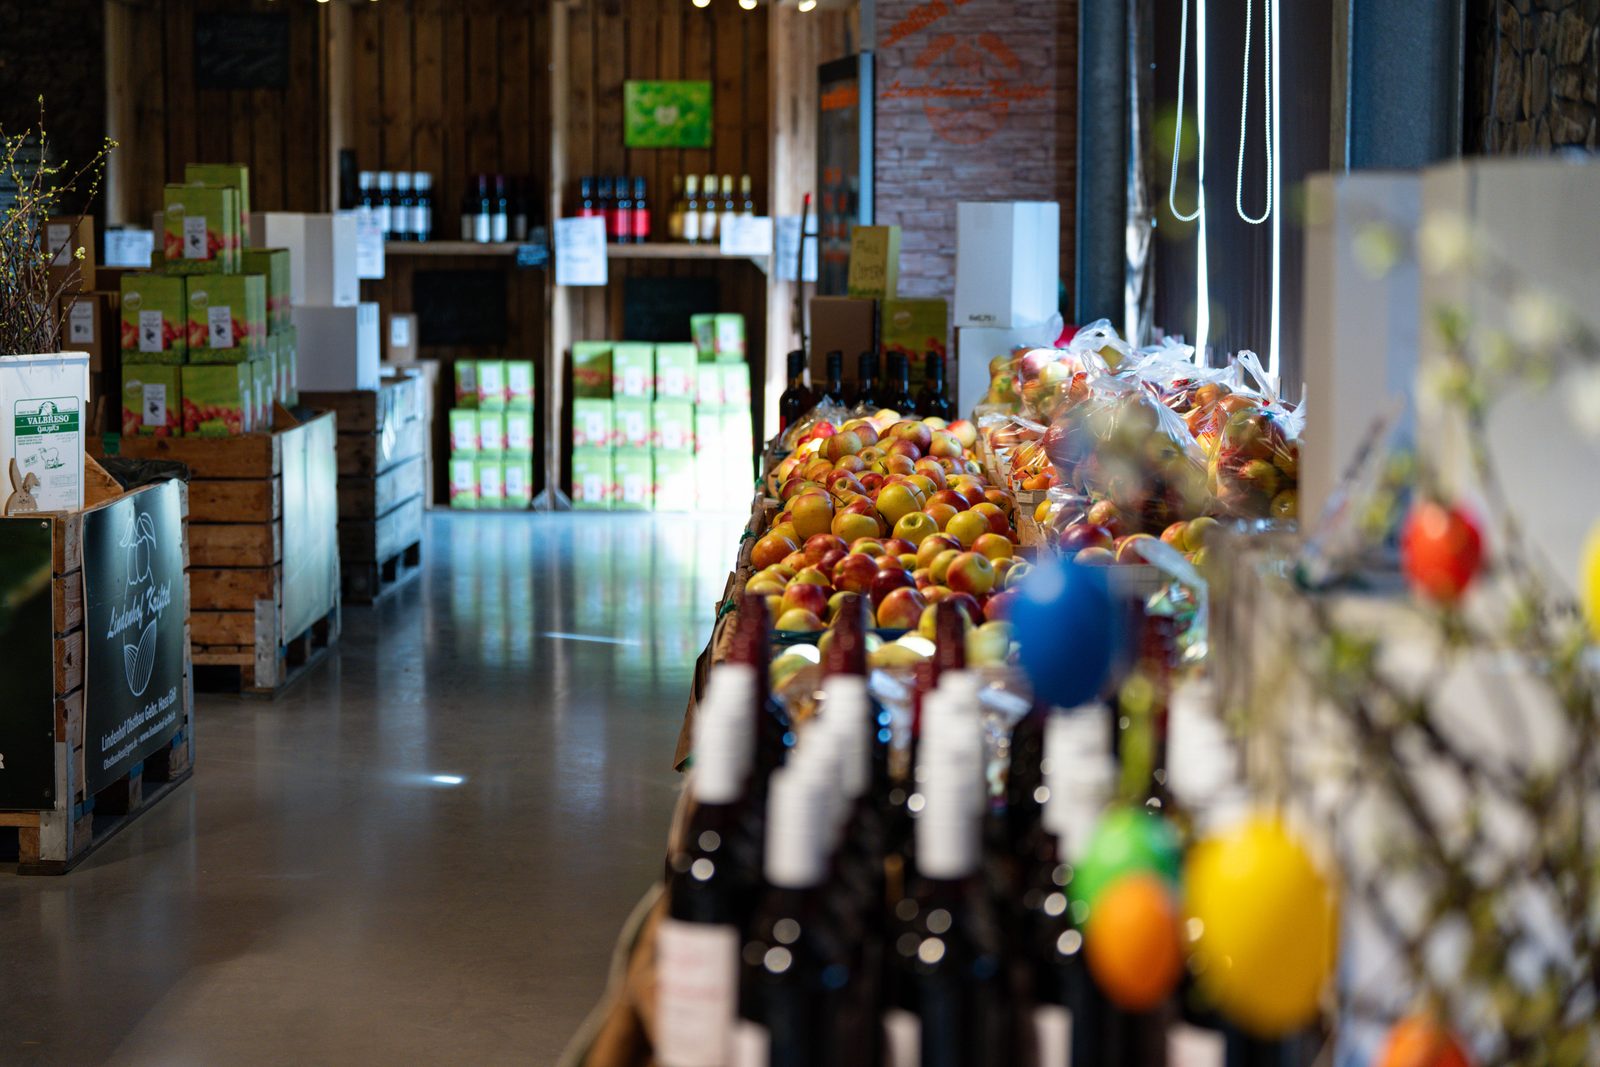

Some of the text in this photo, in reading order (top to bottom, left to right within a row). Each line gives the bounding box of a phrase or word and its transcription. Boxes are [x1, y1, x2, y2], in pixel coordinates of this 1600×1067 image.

[27, 414, 69, 425] VALBRESO
[106, 578, 171, 640] Lindenhof Kriftel
[101, 719, 127, 752] Lindenhof
[126, 711, 145, 734] Obstbau
[144, 701, 158, 721] Gebr.
